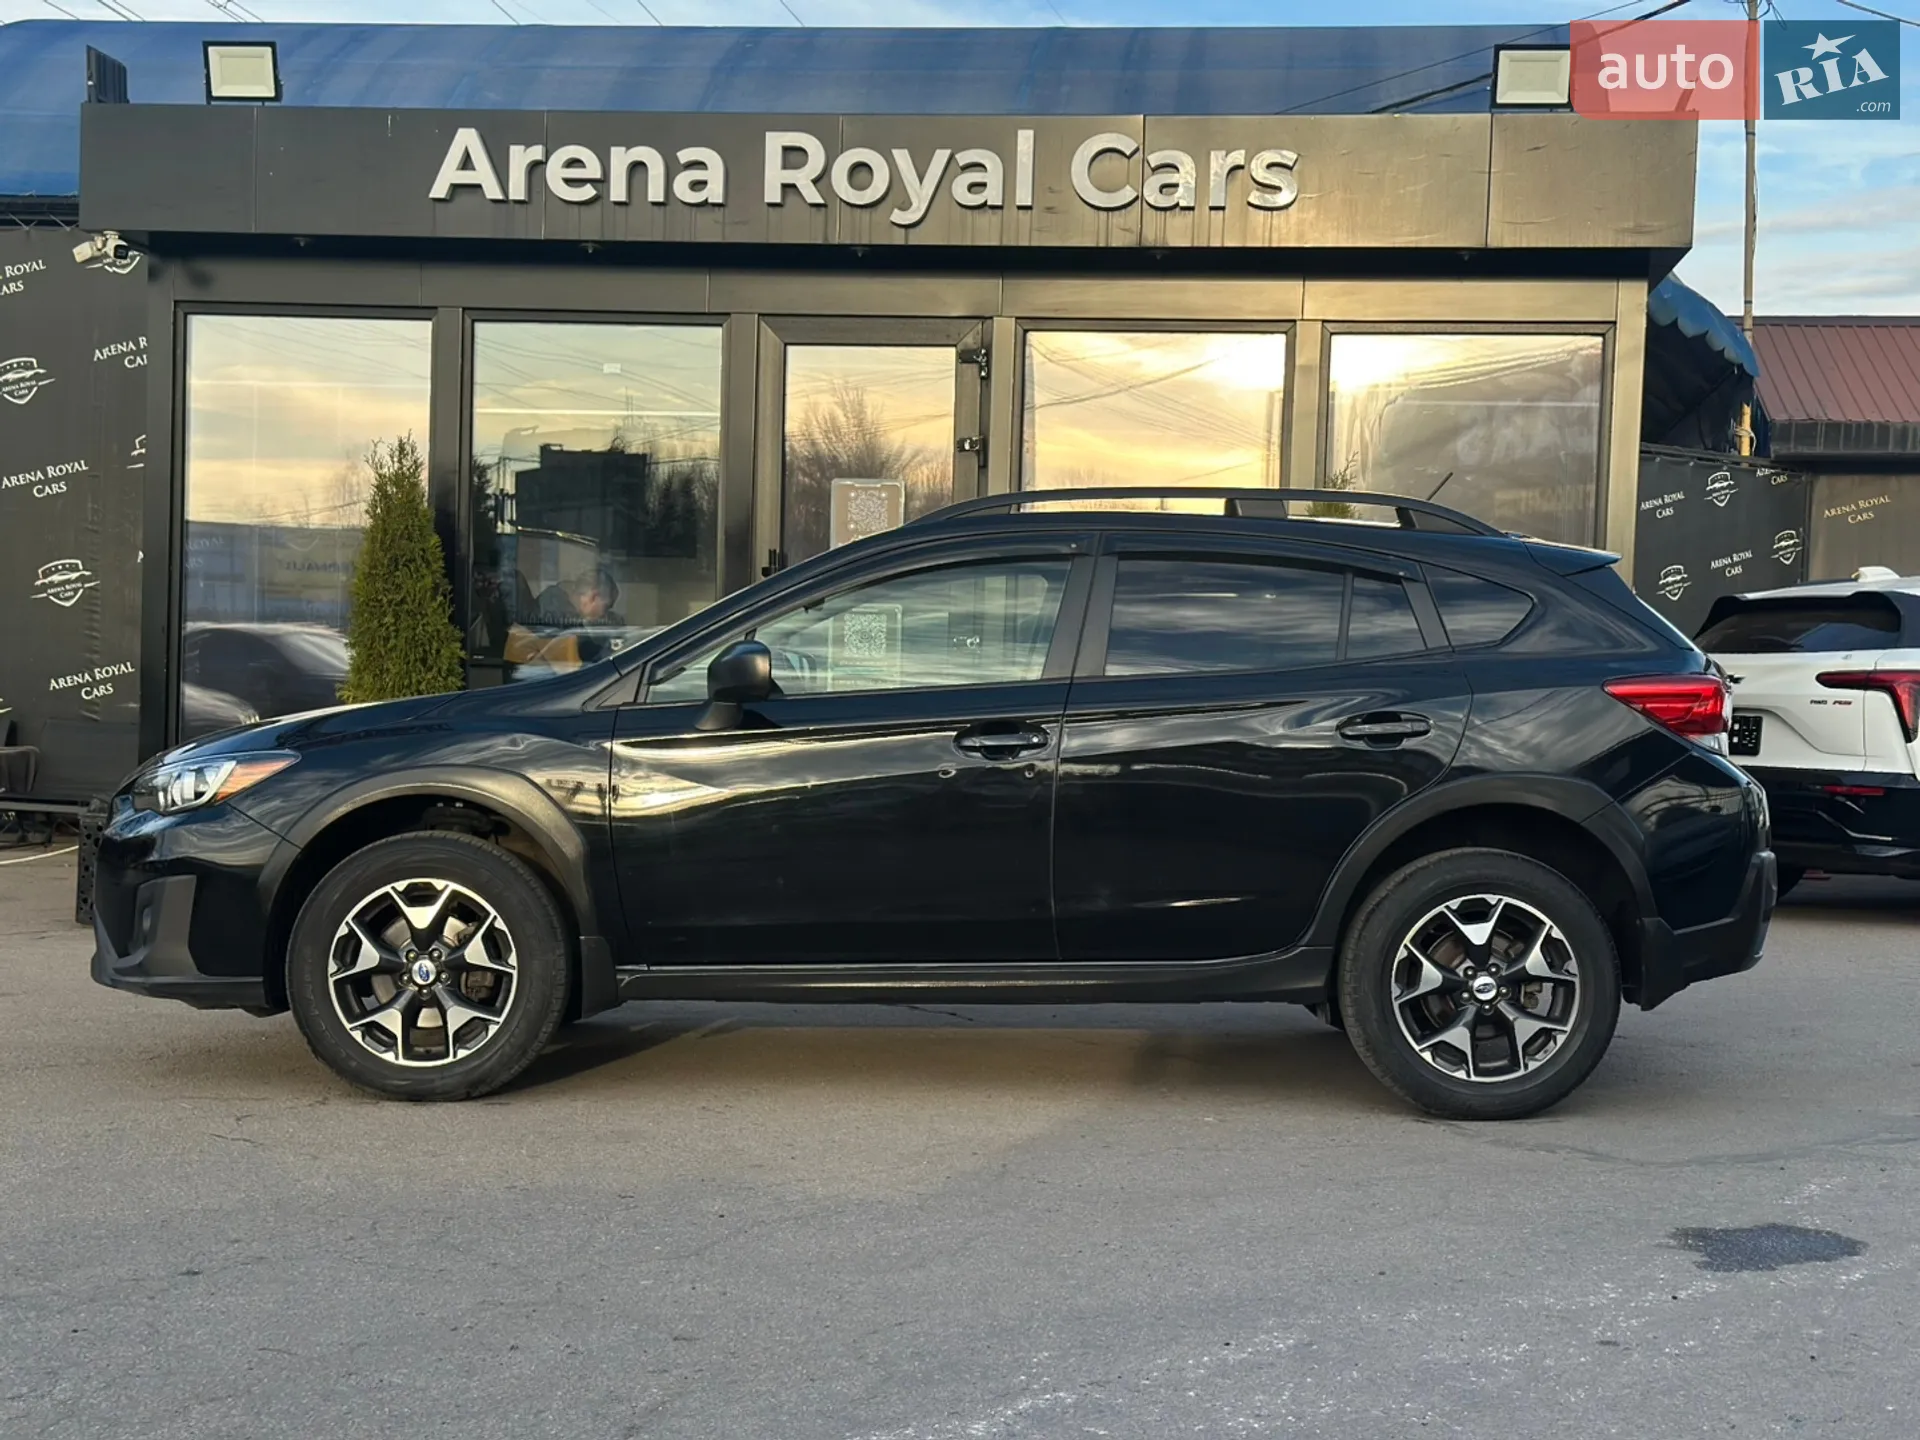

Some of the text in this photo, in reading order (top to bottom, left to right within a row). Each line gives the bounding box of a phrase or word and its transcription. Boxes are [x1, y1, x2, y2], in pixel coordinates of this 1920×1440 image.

[429, 127, 1299, 228] Arena Royal Cars
[5, 259, 46, 279] ROYAL
[93, 340, 136, 361] ARENA
[1, 459, 89, 489] ARENA ROYAL
[33, 481, 67, 498] CARS
[1640, 490, 1685, 511] ARENA ROYAL
[1823, 495, 1891, 519] ARENA ROYAL
[1656, 506, 1674, 519] CARS
[1848, 510, 1875, 524] CARS
[1710, 556, 1732, 570] ARENA
[1725, 565, 1743, 578] CARS
[49, 661, 135, 691] ARENA ROYAL
[81, 683, 114, 701] CARS
